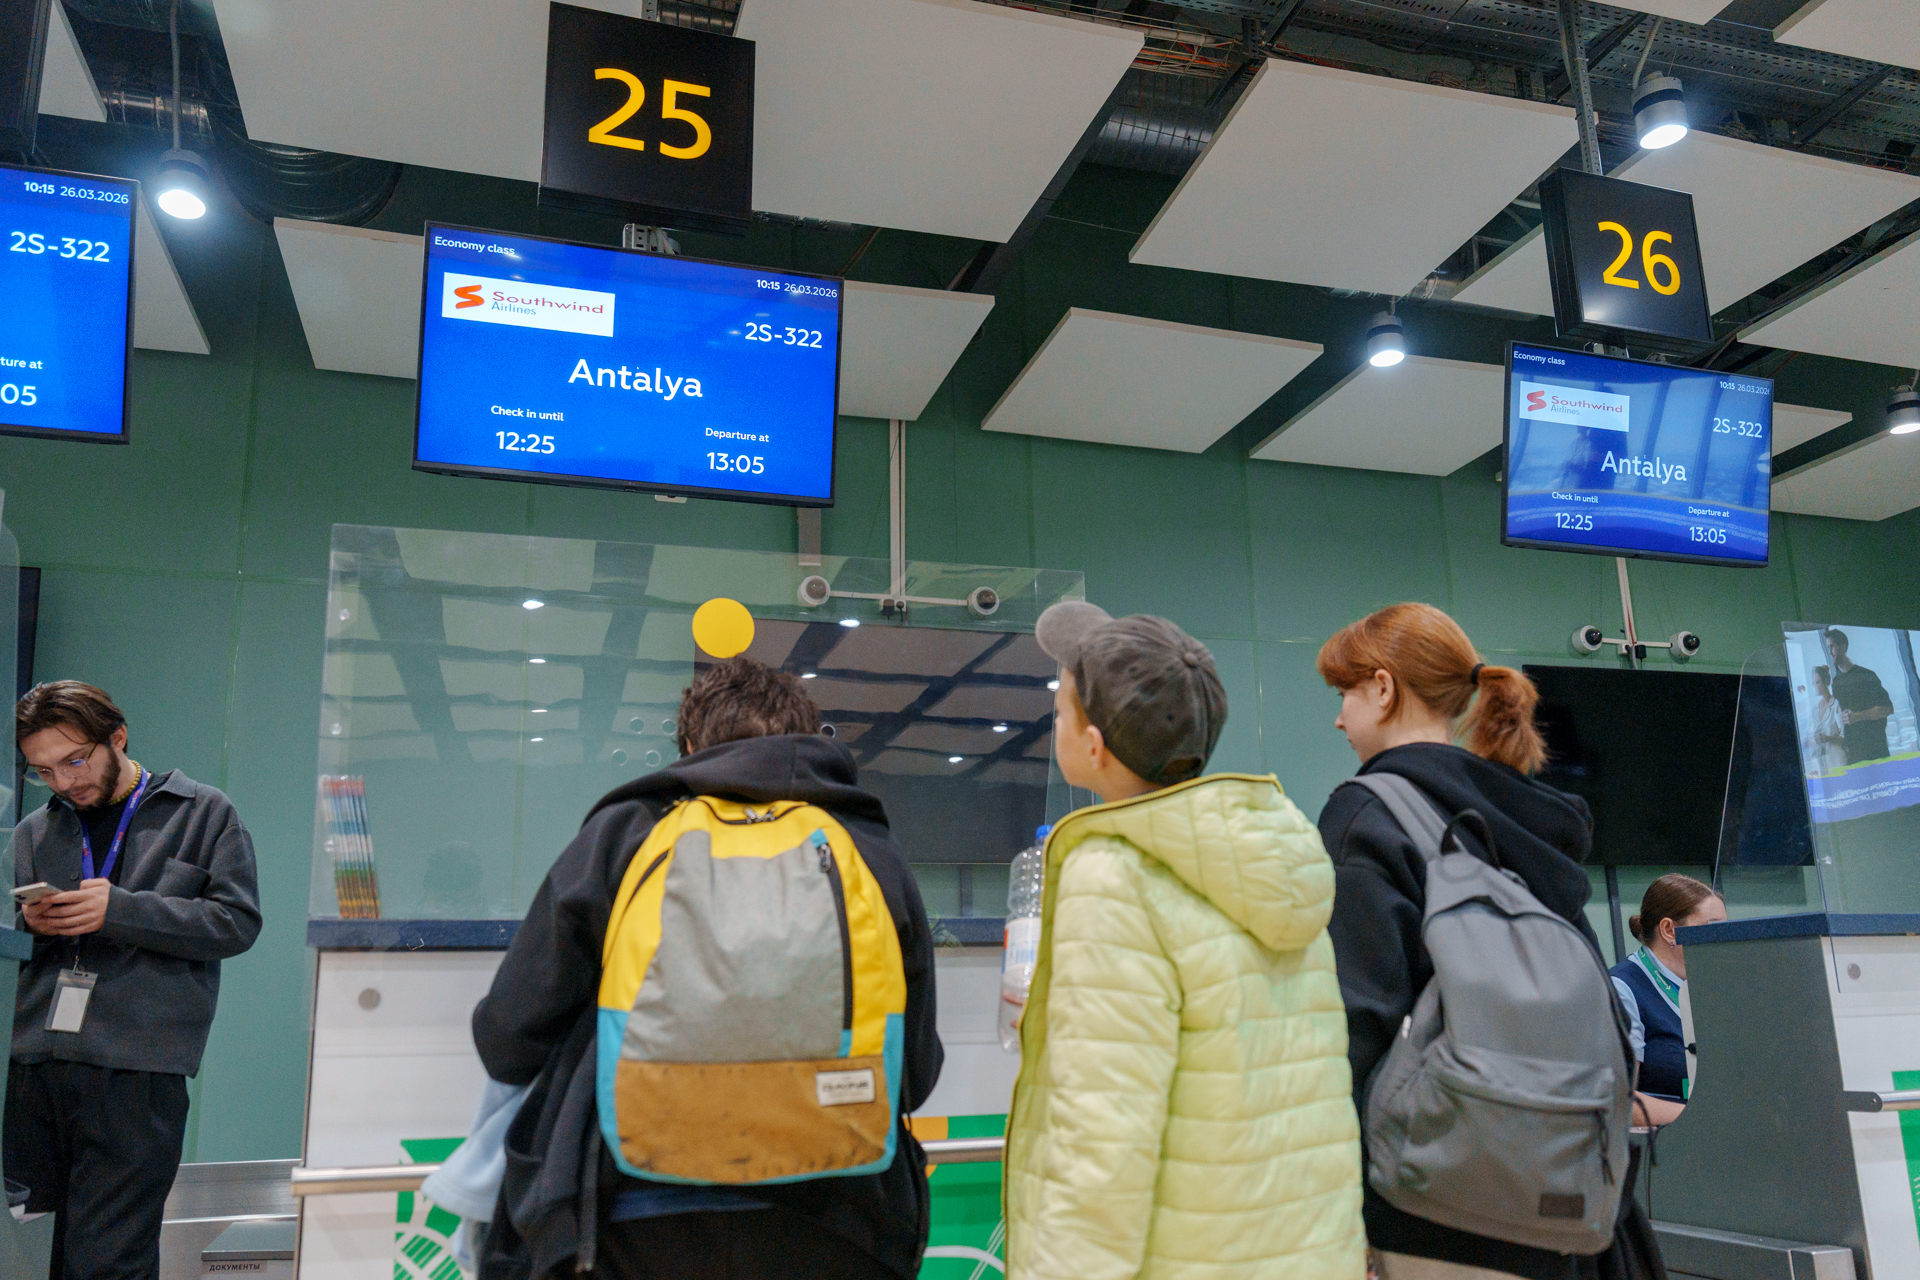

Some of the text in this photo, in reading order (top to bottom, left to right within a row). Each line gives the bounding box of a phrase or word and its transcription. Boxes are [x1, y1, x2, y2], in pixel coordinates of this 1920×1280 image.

[588, 67, 712, 160] 25
[24, 181, 129, 204] 10:15 26.03.2026
[10, 231, 110, 263] 2S-322
[434, 236, 515, 256] Economy class
[1597, 220, 1681, 296] 26
[756, 279, 838, 298] 10:15 26.03.2026
[491, 301, 537, 316] Airlines
[492, 291, 604, 314] Southwind
[744, 322, 823, 349] 2S-322
[28, 360, 44, 370] at
[1513, 350, 1566, 366] Economy class
[567, 358, 703, 402] Antalya
[1719, 381, 1736, 390] 10:15
[490, 405, 564, 422] Check in until
[1550, 404, 1580, 416] Airlines
[1551, 395, 1623, 414] Southwind
[705, 427, 770, 443] Departure at
[1712, 417, 1763, 439] 2S-322
[495, 430, 556, 454] 12:25
[706, 451, 765, 475] 13:05
[1600, 450, 1687, 485] Antalya
[1551, 491, 1599, 504] Check in until
[1554, 512, 1594, 531] 12:25
[1688, 506, 1721, 518] Departure
[1722, 508, 1730, 518] at
[1689, 526, 1726, 545] 13:05
[209, 1263, 260, 1272] ДОКУМЕНТЫ
